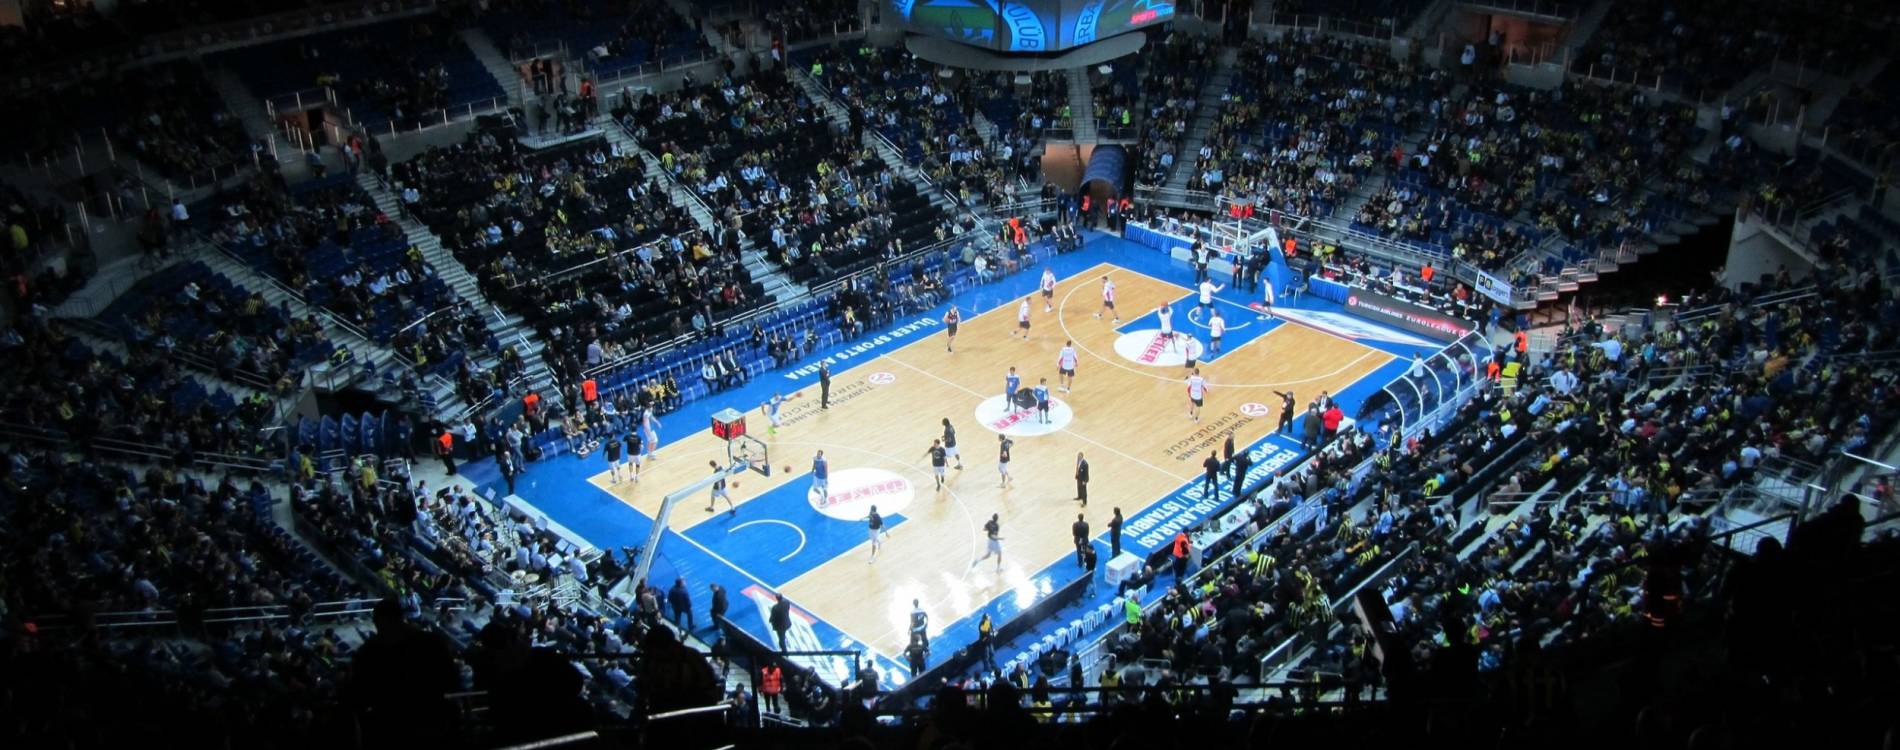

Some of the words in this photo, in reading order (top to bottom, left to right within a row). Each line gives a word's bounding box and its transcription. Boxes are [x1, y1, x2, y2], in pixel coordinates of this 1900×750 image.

[836, 335, 892, 360] SPORTS
[779, 380, 865, 420] EUROEAGU
[1164, 411, 1239, 455] EUROLEAGUE
